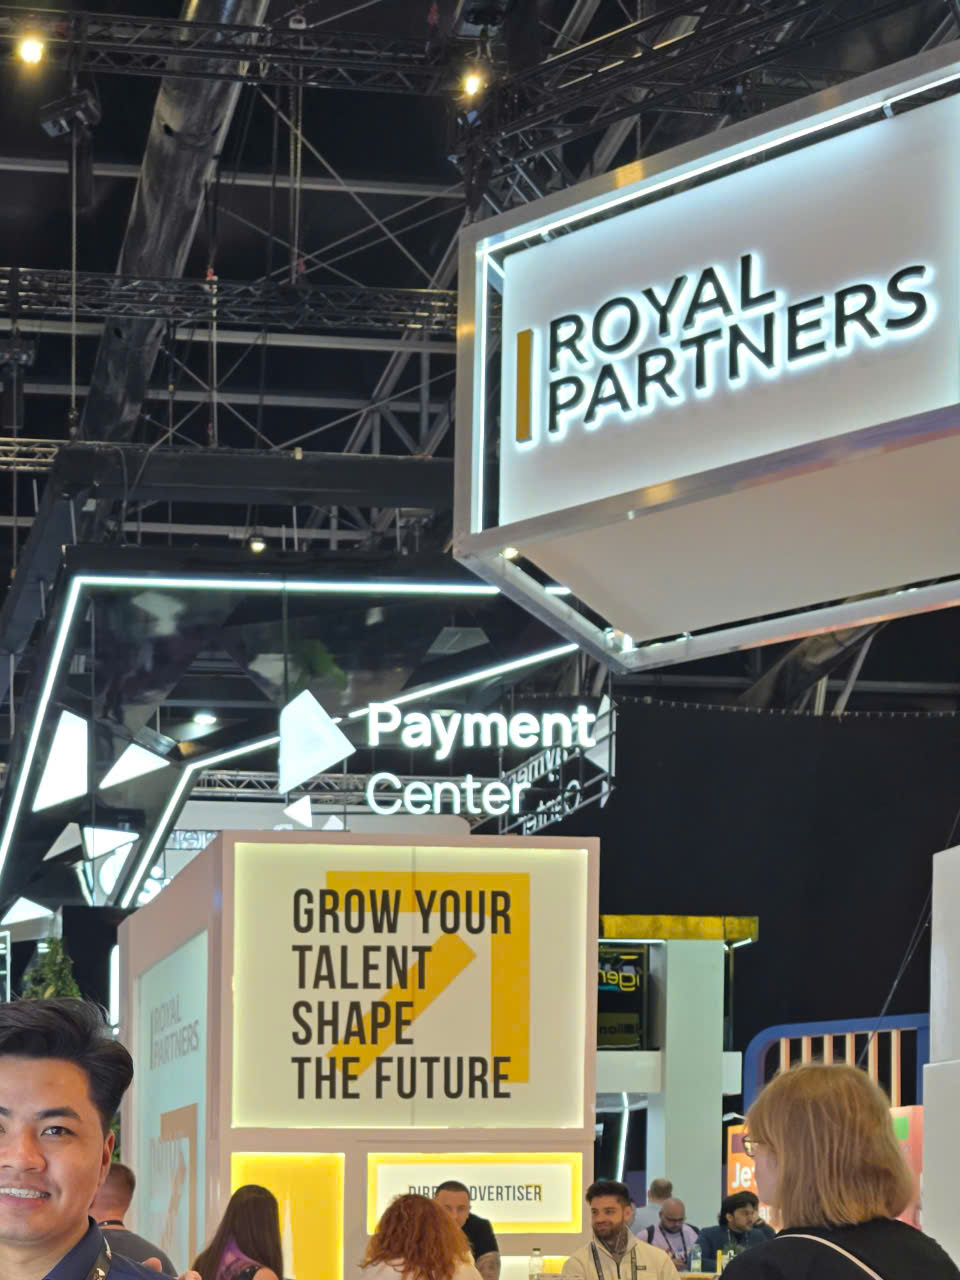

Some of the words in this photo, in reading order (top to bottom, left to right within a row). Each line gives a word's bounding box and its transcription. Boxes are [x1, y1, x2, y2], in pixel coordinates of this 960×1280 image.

[548, 253, 776, 372] ROYAL
[547, 264, 930, 434] PARTNERS
[367, 702, 597, 760] Payment
[366, 772, 532, 816] Center
[292, 888, 401, 935] GROW
[414, 889, 512, 935] YOUR
[291, 945, 432, 990] TALENT
[153, 994, 181, 1035] ROYAL
[291, 1001, 415, 1046] SHAPE
[153, 1020, 200, 1070] PARTNERS
[291, 1056, 360, 1099] THE
[375, 1056, 512, 1099] FUTURE
[470, 1185, 542, 1201] DVERTISER
